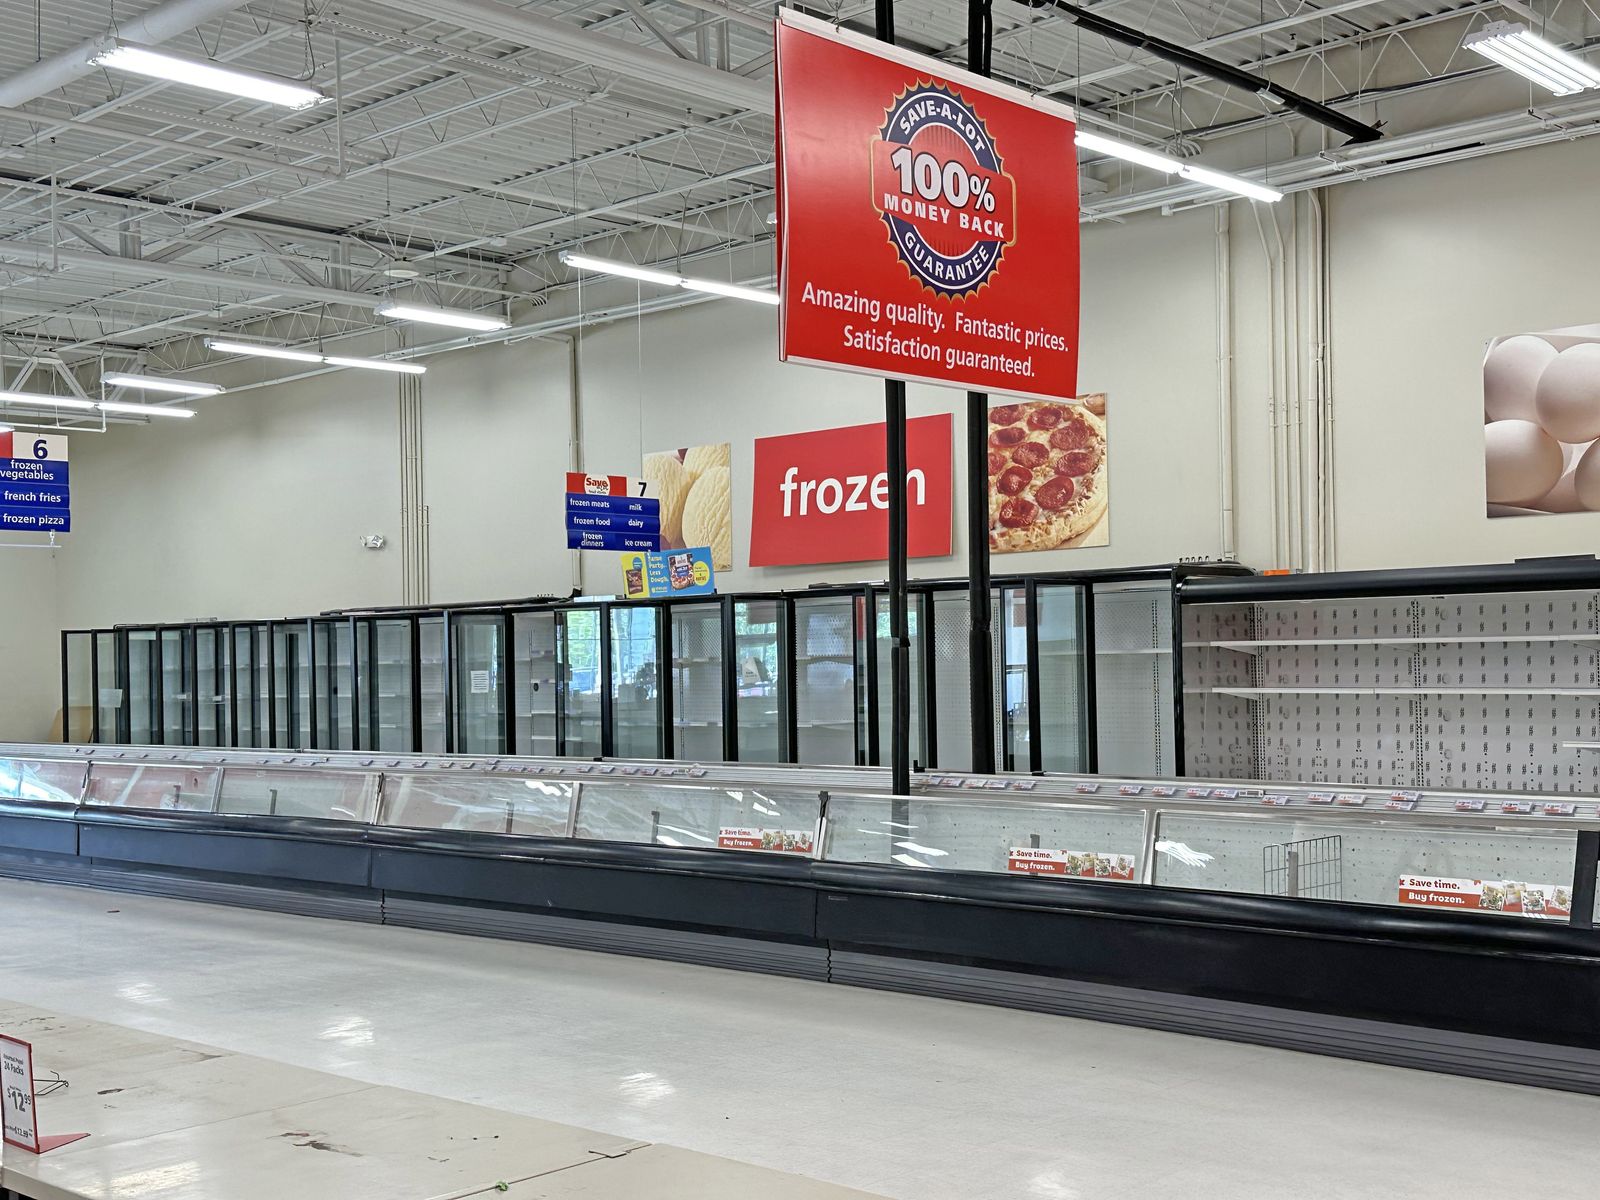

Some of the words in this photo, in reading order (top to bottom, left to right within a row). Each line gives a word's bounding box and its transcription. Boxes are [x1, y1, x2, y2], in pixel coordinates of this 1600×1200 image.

[899, 100, 985, 152] SAVE-A-LOT
[891, 146, 995, 213] 100%
[884, 193, 950, 224] MONEY
[959, 212, 1004, 238] BACK
[904, 231, 990, 280] GUARANTEE
[801, 281, 880, 322] Amazing
[886, 301, 945, 330] quality.
[955, 311, 1021, 343] Fantastic
[1025, 327, 1069, 352] prices.
[843, 325, 941, 362] Satisfaction
[945, 347, 1035, 377] guaranteed.
[33, 439, 48, 459] 6
[10, 459, 43, 470] frozen
[0, 470, 54, 480] vegetables
[585, 477, 608, 488] Save
[638, 481, 647, 497] 7
[779, 466, 926, 517] frozen
[4, 490, 36, 502] french
[39, 492, 61, 503] fries
[570, 498, 590, 507] frozen
[629, 503, 642, 511] milk
[3, 513, 36, 524] frozen
[38, 514, 65, 526] pizza
[573, 516, 595, 525] frozen
[595, 517, 611, 526] food
[628, 518, 644, 528] dairy
[582, 532, 603, 540] frozen
[580, 539, 604, 547] dinners
[624, 539, 633, 547] ice
[723, 838, 733, 846] Buy
[734, 839, 754, 847] frozen.
[1016, 850, 1033, 858] Save
[1033, 850, 1052, 859] time.
[1015, 862, 1029, 870] Buy
[1029, 861, 1055, 871] frozen.
[1409, 878, 1433, 888] Save
[1434, 879, 1460, 890] time.
[1408, 892, 1427, 902] Buy
[1429, 891, 1465, 904] frozen.
